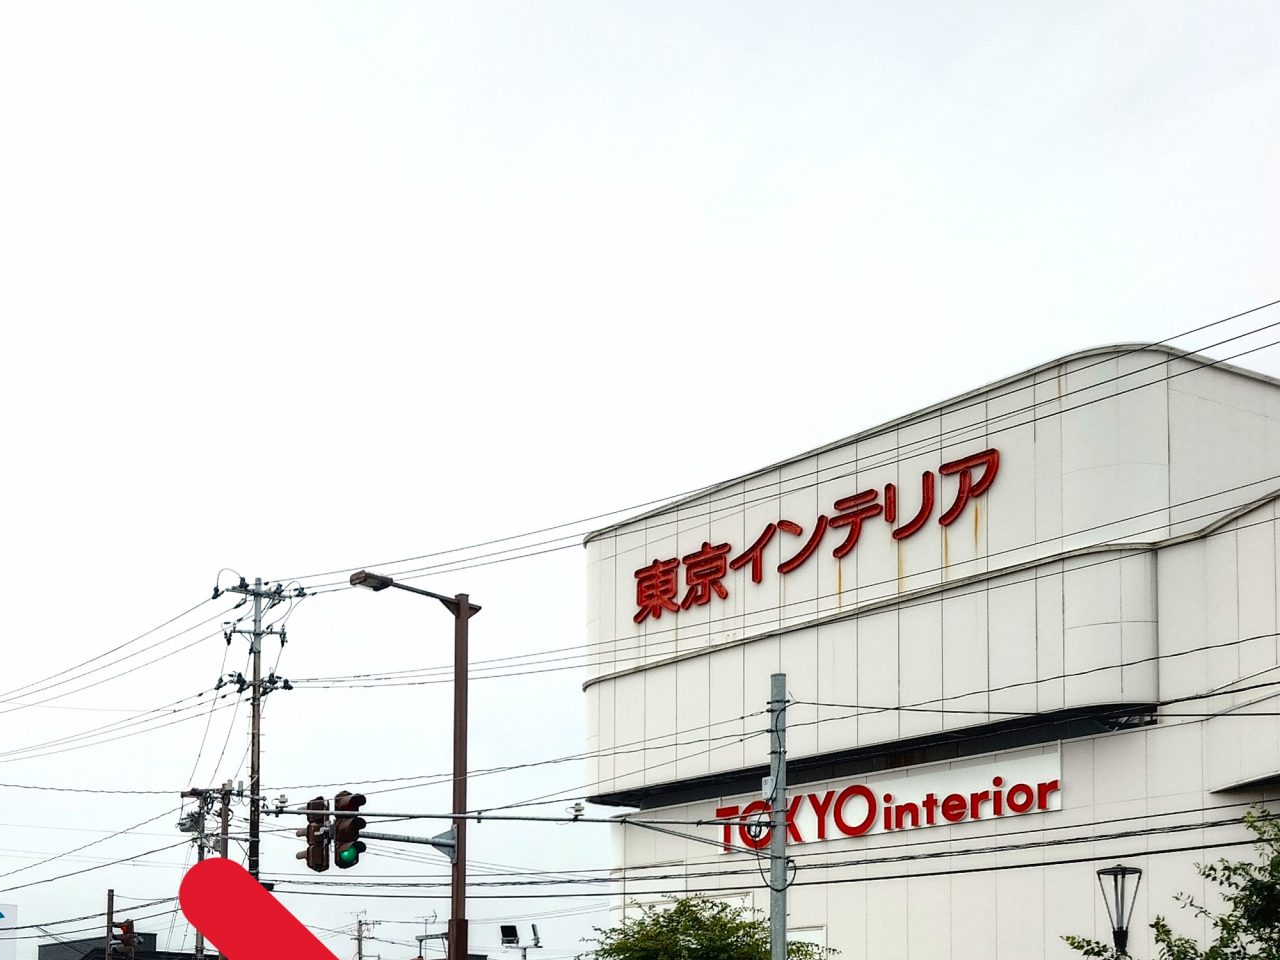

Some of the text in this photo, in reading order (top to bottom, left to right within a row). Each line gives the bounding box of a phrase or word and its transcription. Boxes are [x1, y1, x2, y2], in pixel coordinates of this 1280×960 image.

[633, 448, 1000, 624] 東京インテリア
[715, 776, 1061, 853] TOKYO interior
